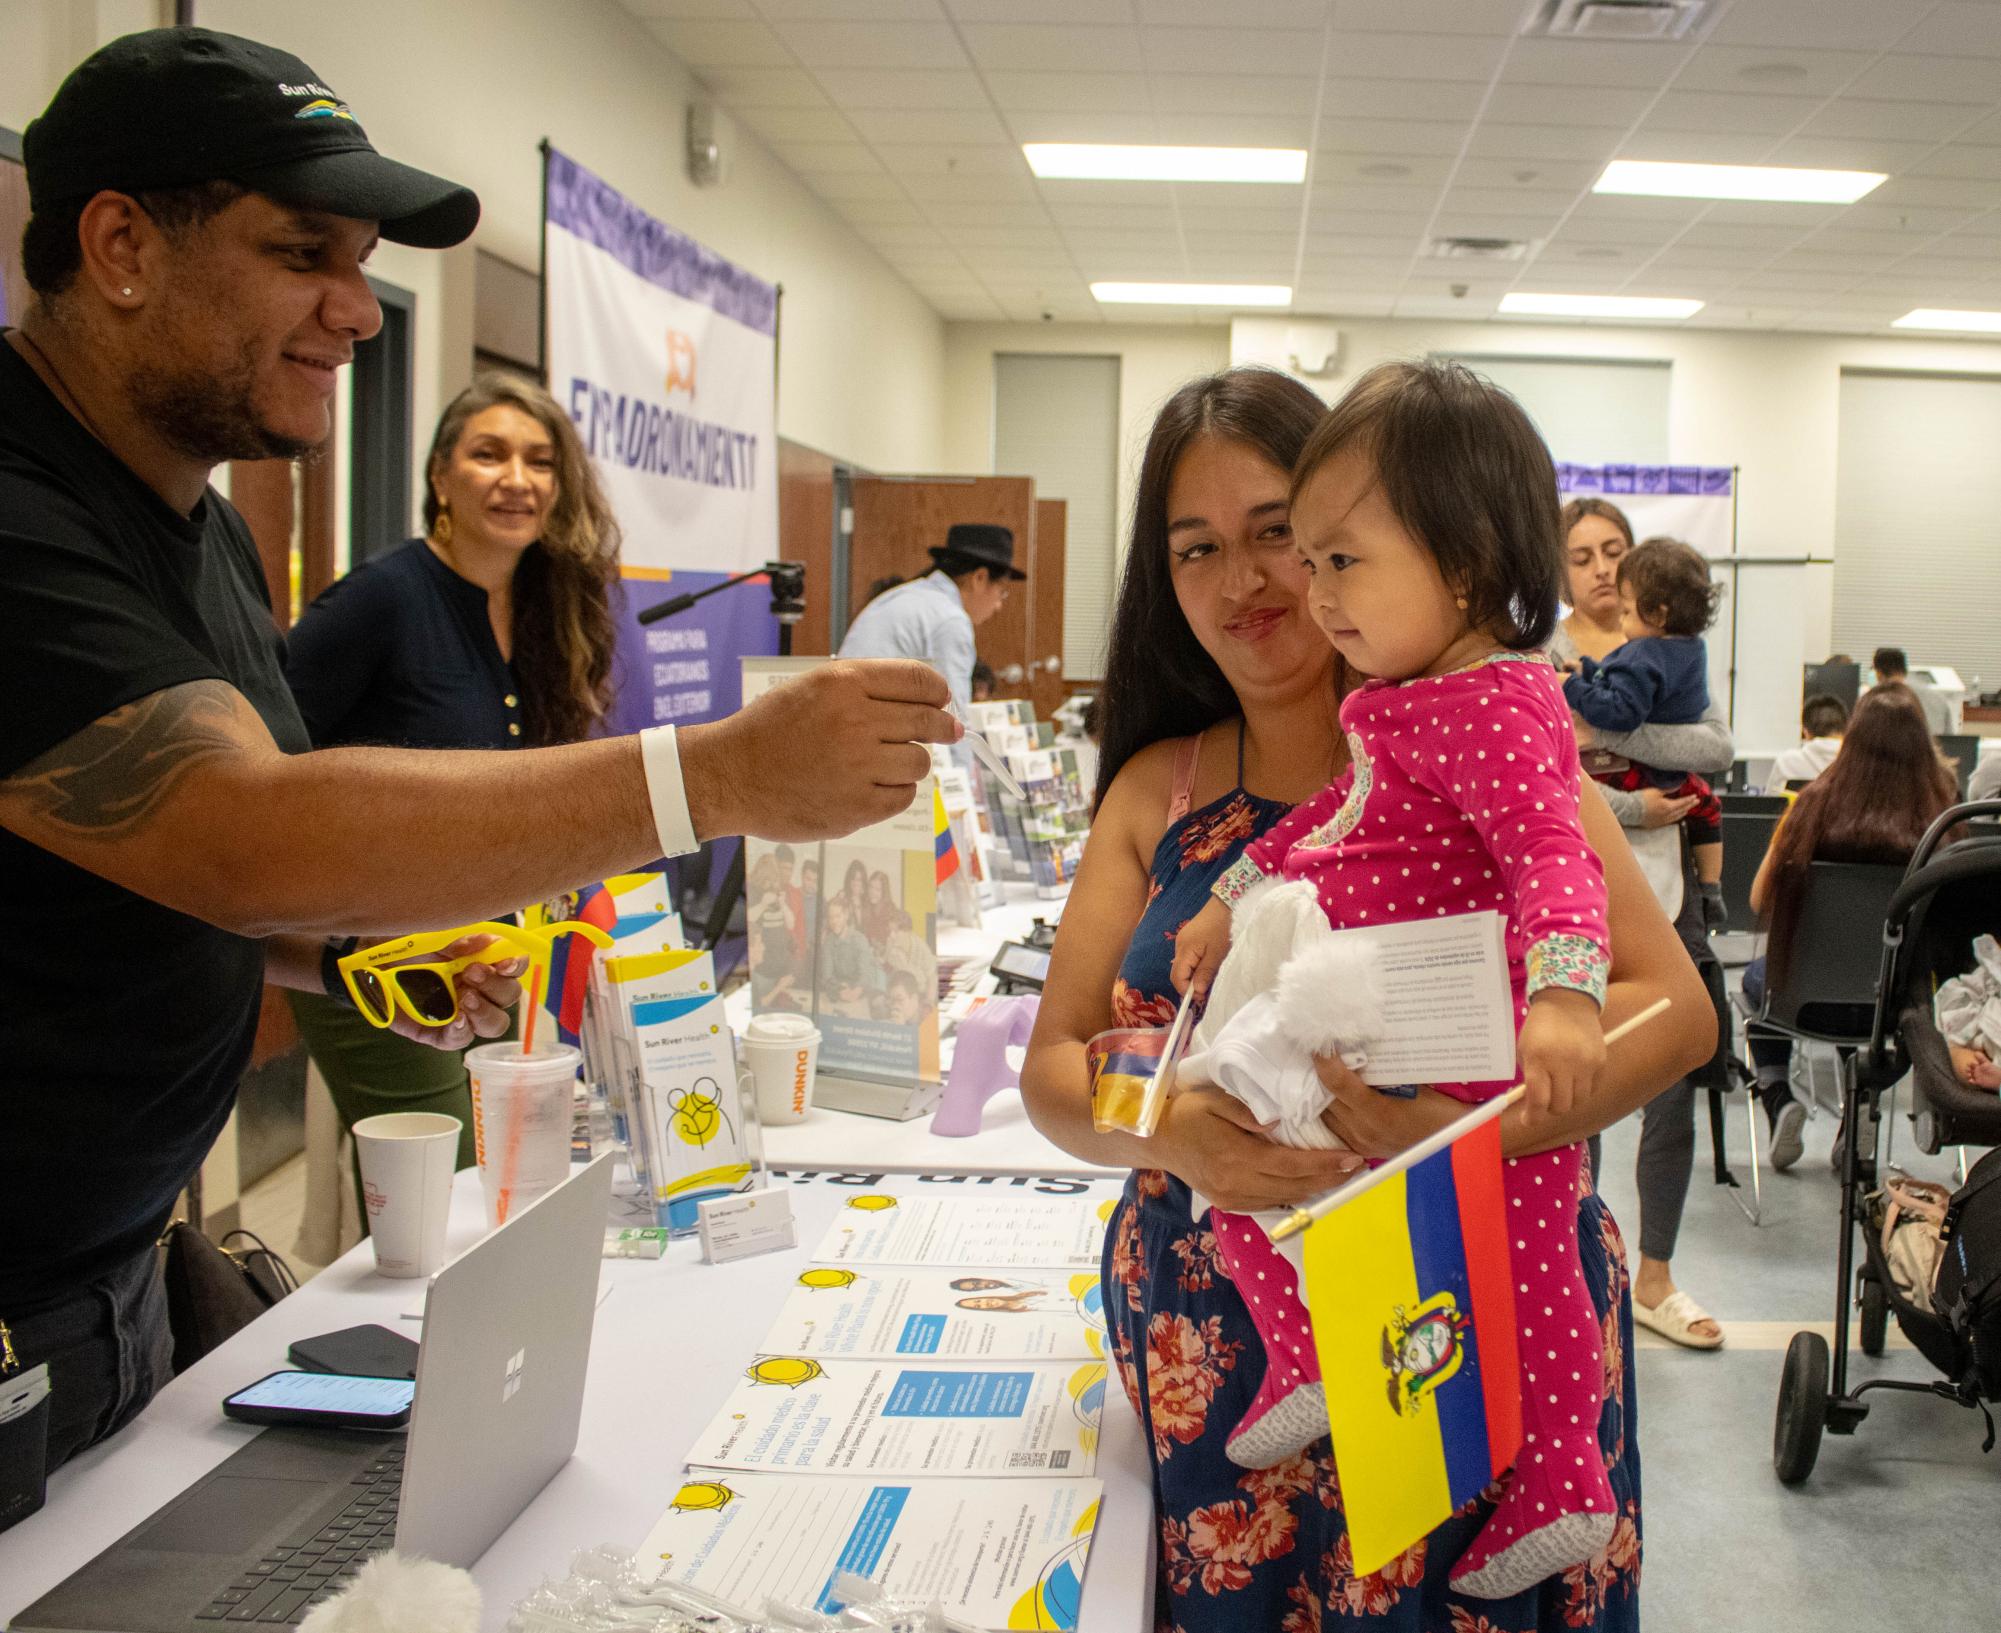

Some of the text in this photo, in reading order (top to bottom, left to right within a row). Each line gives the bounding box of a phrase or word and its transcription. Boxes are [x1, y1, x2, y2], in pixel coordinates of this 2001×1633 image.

[278, 83, 307, 96] Sun
[644, 1033, 710, 1048] Sun River Health
[859, 1296, 876, 1308] now
[817, 1303, 855, 1352] Sun River Health
[846, 1314, 869, 1332] Plains
[799, 1335, 812, 1343] River
[837, 1333, 861, 1352] White
[743, 1397, 798, 1462] El cuidado médico
[767, 1429, 805, 1464] primario
[791, 1420, 807, 1428] es
[800, 1393, 823, 1411] clave
[720, 1435, 740, 1449] River
[792, 1416, 833, 1465] para la salud
[713, 1449, 731, 1459] Sun
[693, 1530, 724, 1558] Cuidados
[688, 1560, 704, 1568] de
